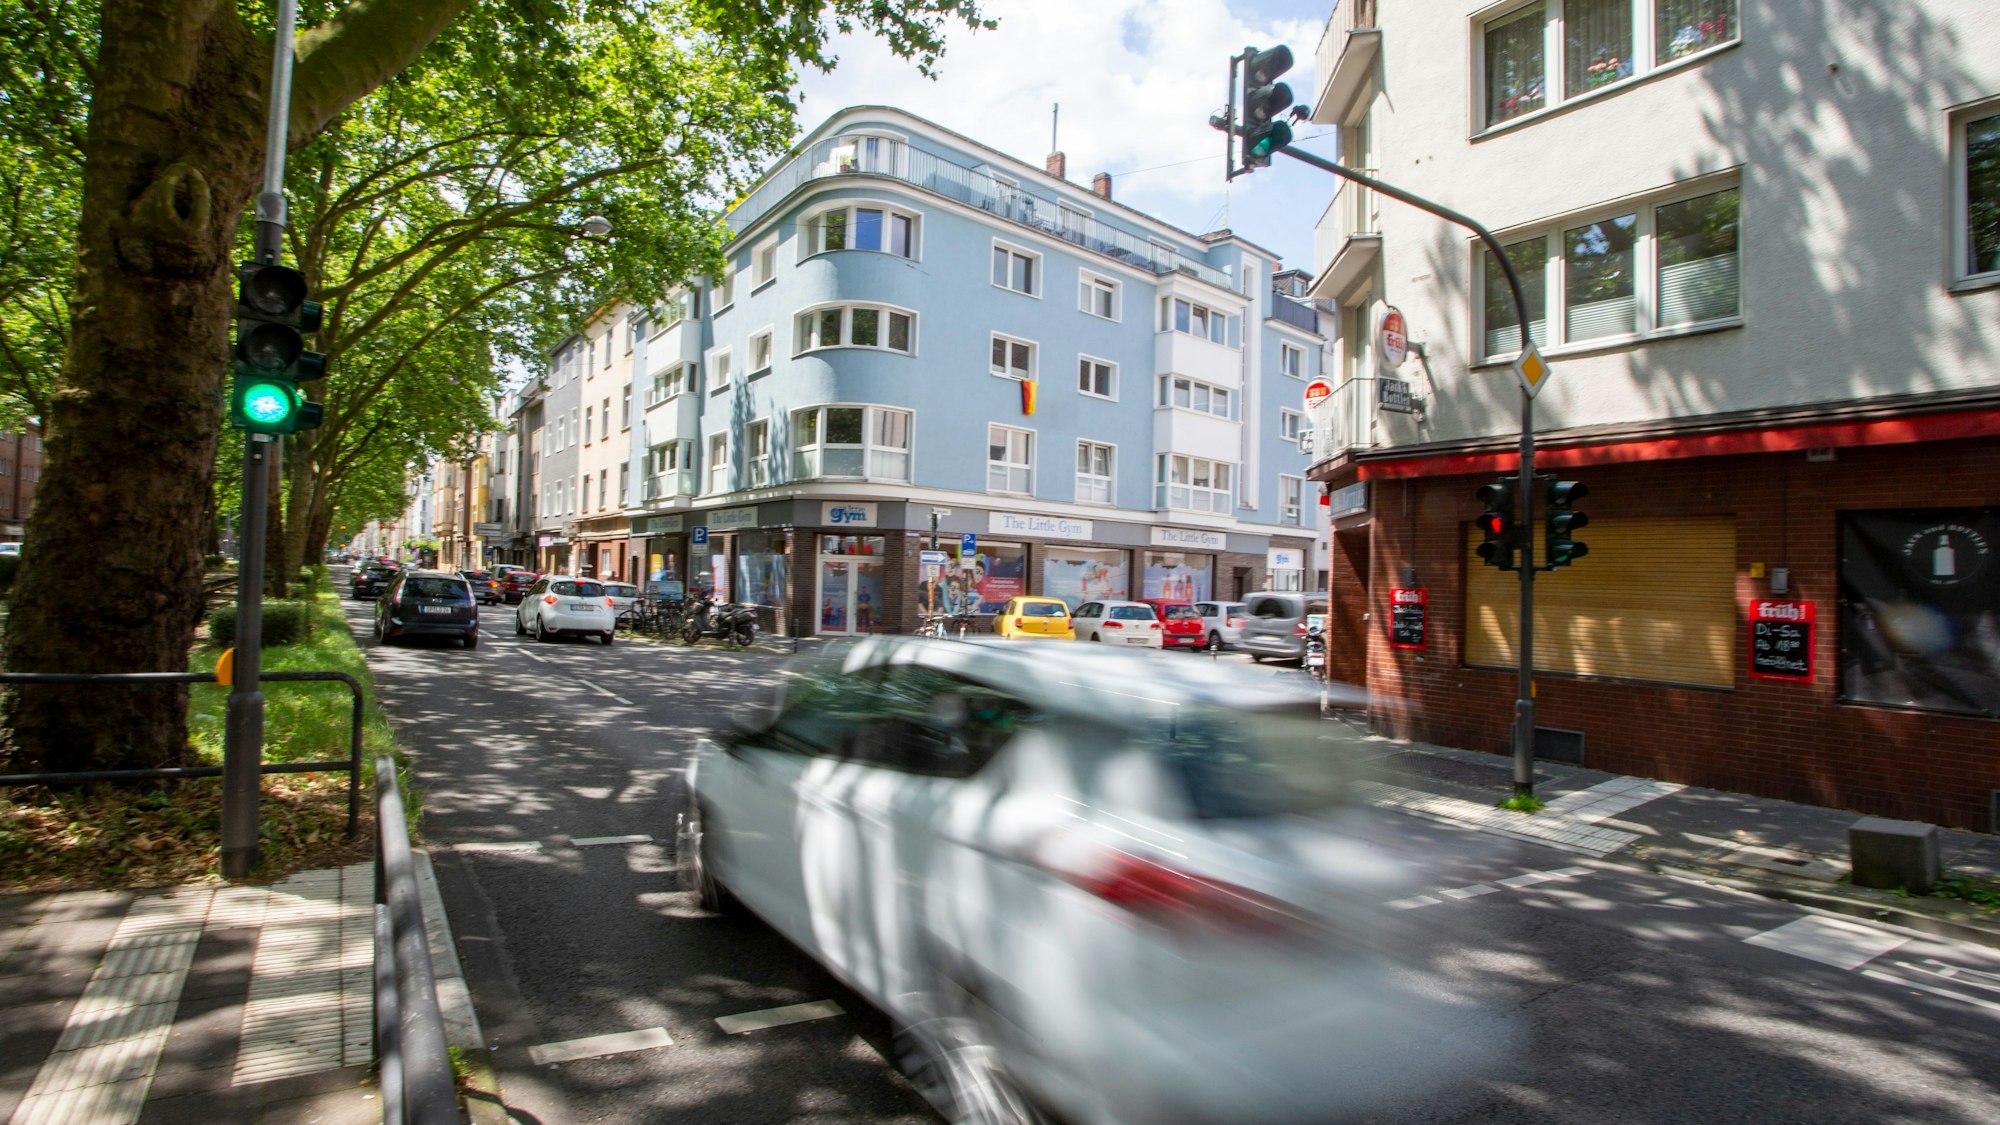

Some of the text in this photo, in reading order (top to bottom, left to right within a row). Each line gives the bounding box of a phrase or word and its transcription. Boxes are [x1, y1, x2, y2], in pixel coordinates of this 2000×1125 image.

[830, 507, 867, 523] gym
[1003, 514, 1082, 536] The Little Gym
[695, 528, 704, 542] P
[963, 534, 971, 544] P
[1161, 529, 1218, 547] The Little Gym
[1757, 602, 1799, 620] früh
[1755, 639, 1771, 650] Ab
